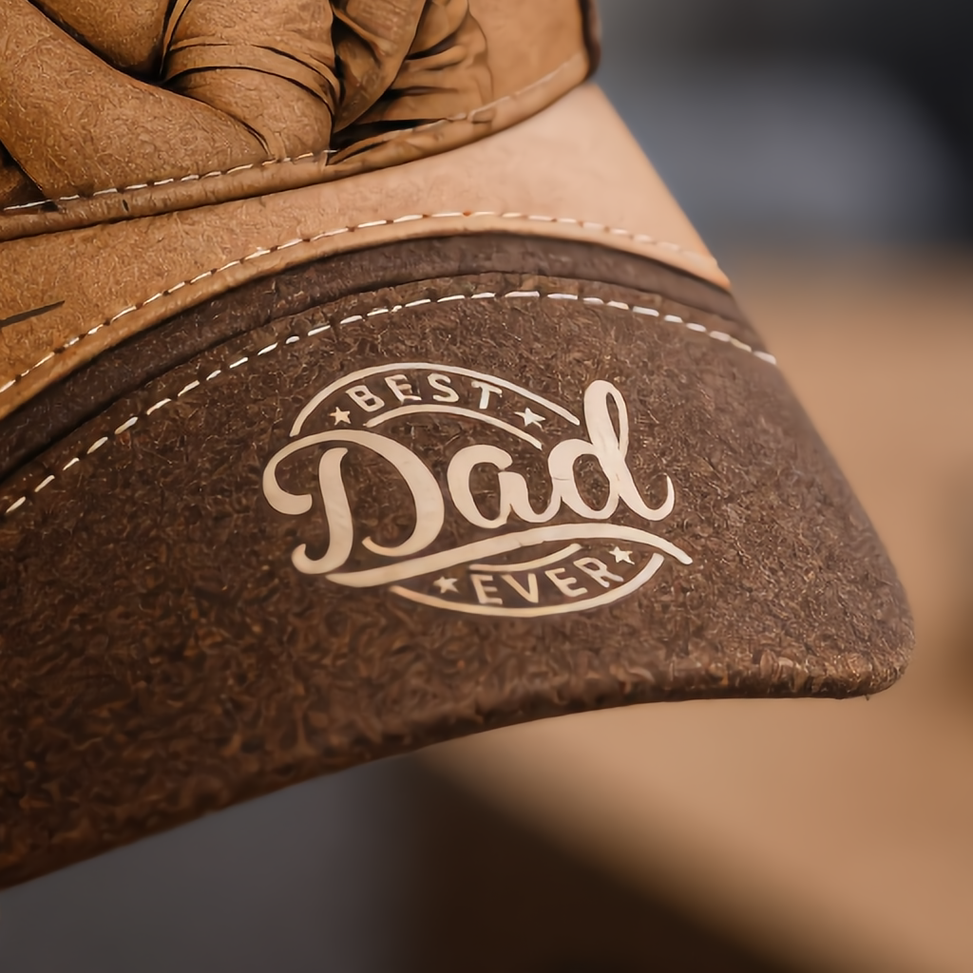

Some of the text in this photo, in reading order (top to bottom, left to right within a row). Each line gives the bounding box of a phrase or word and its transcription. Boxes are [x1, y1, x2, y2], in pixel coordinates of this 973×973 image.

[345, 373, 503, 413] BEST
[262, 379, 675, 575] Dad
[471, 556, 625, 606] EVER
